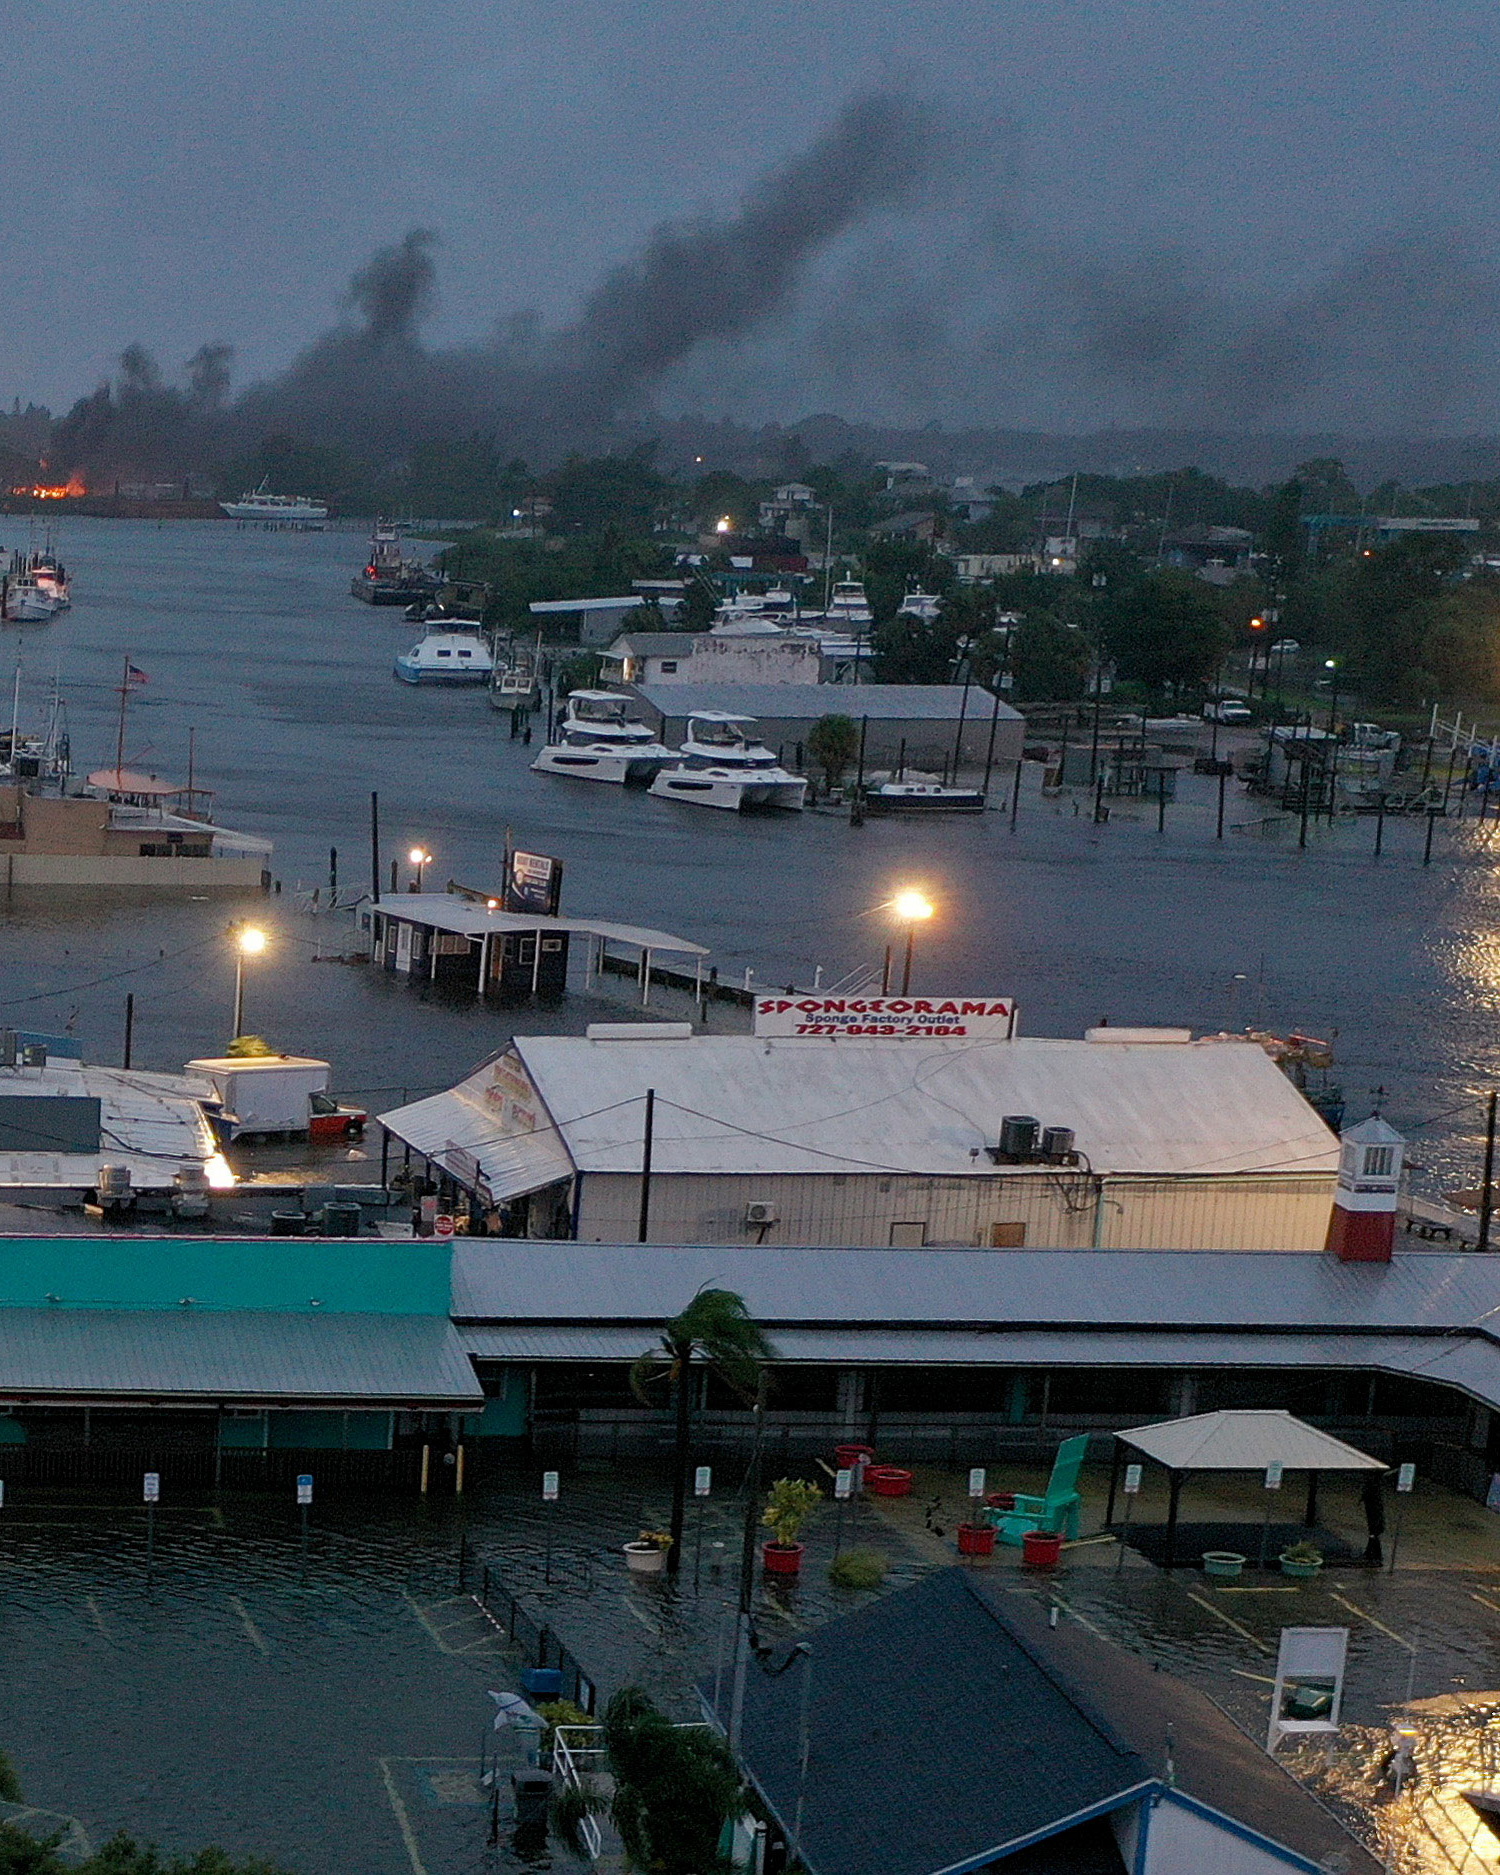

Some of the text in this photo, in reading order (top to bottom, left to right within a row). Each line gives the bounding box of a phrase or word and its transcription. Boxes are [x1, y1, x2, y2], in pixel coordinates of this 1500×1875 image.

[757, 1000, 1009, 1016] SPONGEORAMA
[805, 1013, 960, 1025] Sponge Factory Outlet
